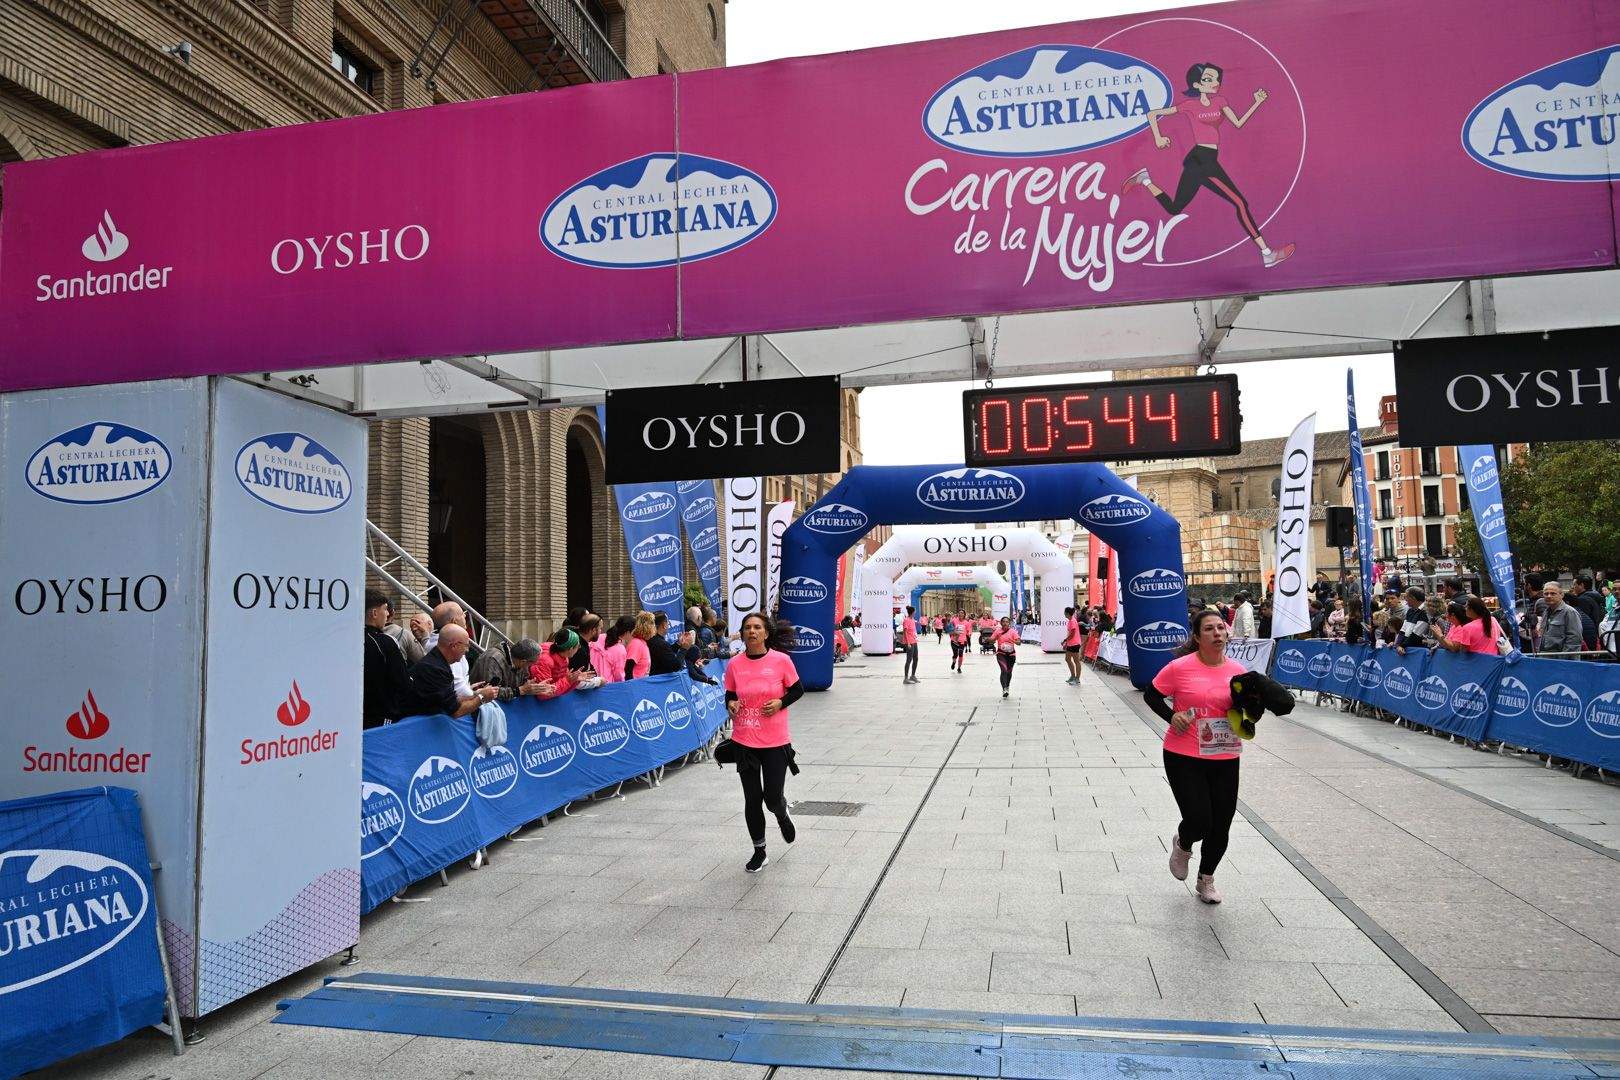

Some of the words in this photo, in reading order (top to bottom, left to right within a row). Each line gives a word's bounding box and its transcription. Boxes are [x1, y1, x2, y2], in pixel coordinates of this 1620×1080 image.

[978, 82, 1054, 101] CENTRAL
[1063, 73, 1144, 93] LECHERA
[941, 89, 1151, 136] ASTURIANA
[1488, 107, 1620, 157] ASTU
[593, 192, 665, 210] CENTRAL
[672, 183, 750, 201] LECHERA
[904, 158, 1106, 216] Carrera
[557, 199, 759, 247] ASTURIANA
[270, 224, 430, 275] OYSHO
[953, 214, 991, 255] de
[1000, 211, 1027, 252] la
[1021, 194, 1190, 292] Mujer
[36, 264, 173, 302] Santander
[1445, 366, 1620, 413] OYSH
[641, 410, 807, 452] OYSHO
[59, 450, 105, 461] CENTRAL
[109, 447, 157, 458] LECHERA
[264, 454, 304, 470] CENTRAL
[35, 455, 161, 486] ASTURIANA
[244, 453, 345, 500] ASTURIANA
[1393, 454, 1403, 499] HOTEL
[924, 482, 1017, 502] ASTURIANA
[806, 514, 863, 527] ASTURIANA
[1085, 507, 1147, 519] ASTURIANA
[1278, 448, 1309, 598] OYSHO
[924, 534, 1007, 554] OYSHO
[15, 574, 168, 616] OYSHO
[233, 572, 350, 611] OYSHO
[1131, 581, 1183, 593] ASTURIANA
[1136, 633, 1187, 645] ASTURIANA
[1534, 696, 1578, 719] ASTURIANA
[1587, 704, 1620, 727] ASTURI
[239, 729, 339, 766] Santander
[584, 726, 628, 750] ASTURIANA
[23, 746, 151, 774] Santander
[525, 742, 574, 770] ASTURIANA
[473, 761, 516, 789] ASTURIANA
[414, 778, 470, 815] ASTURIANA
[38, 874, 119, 903] LECHERA
